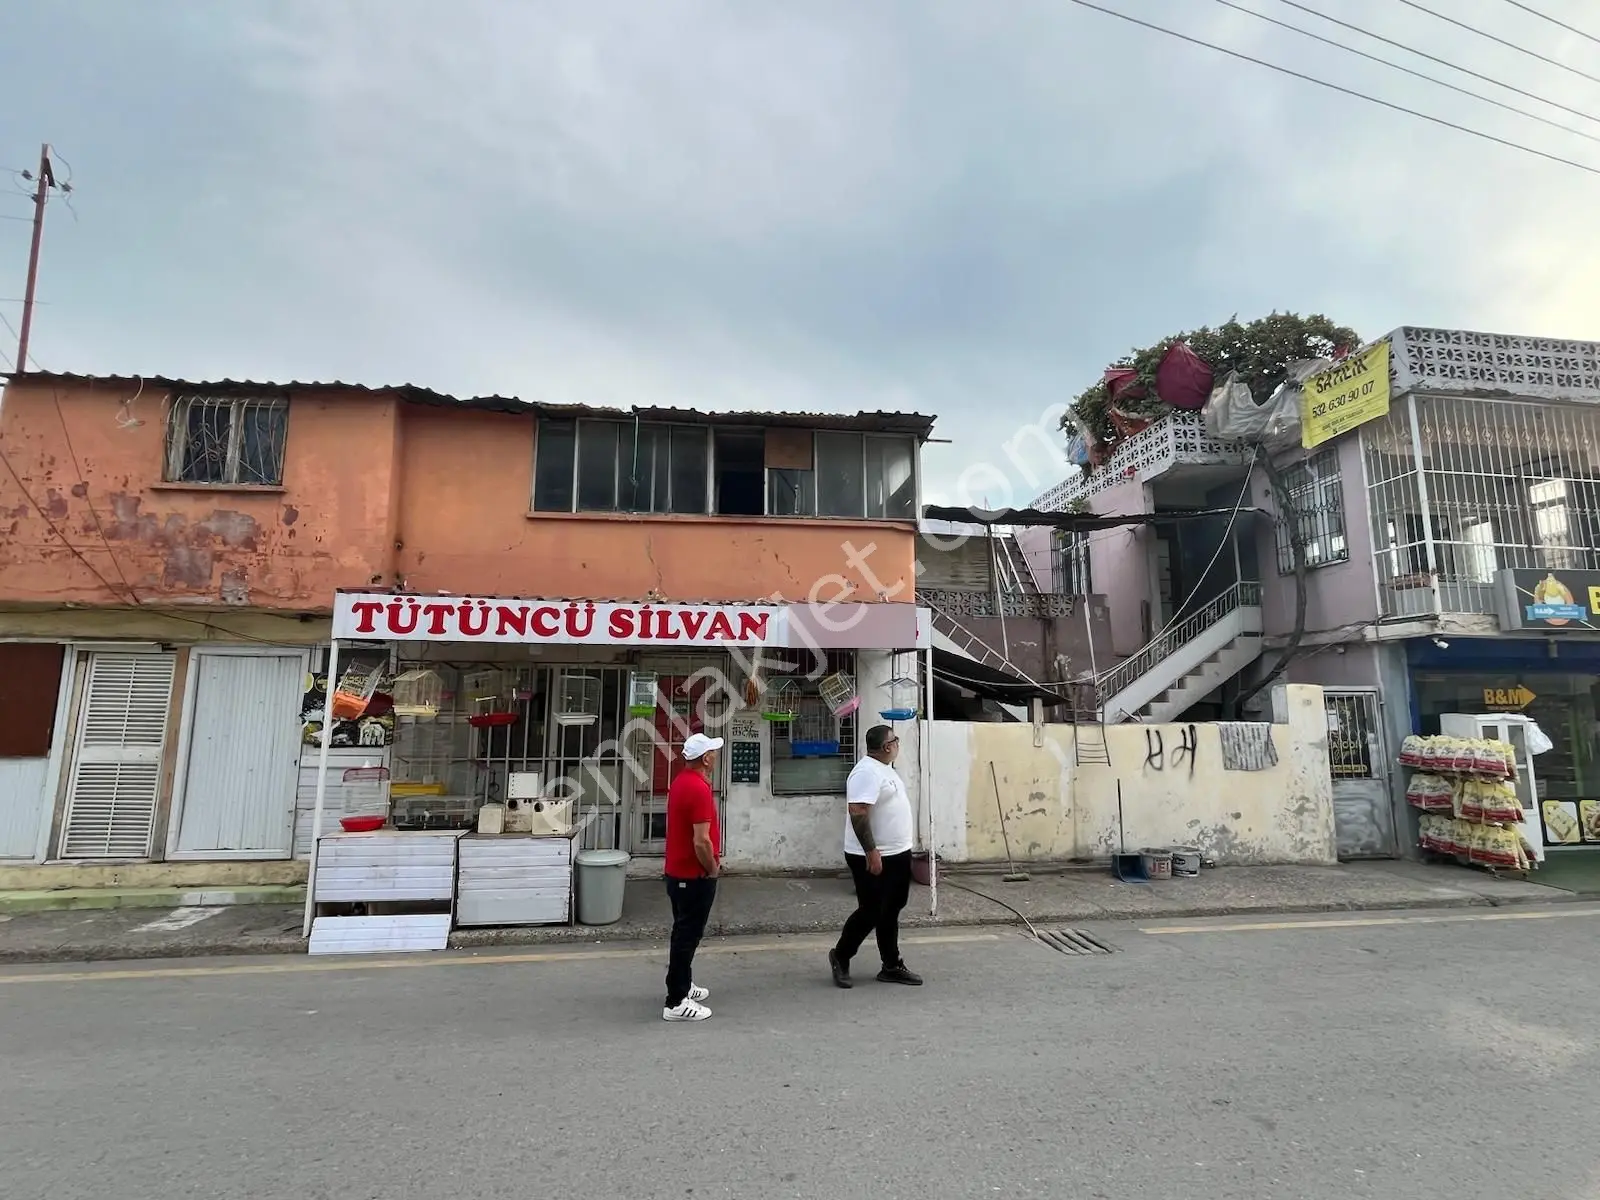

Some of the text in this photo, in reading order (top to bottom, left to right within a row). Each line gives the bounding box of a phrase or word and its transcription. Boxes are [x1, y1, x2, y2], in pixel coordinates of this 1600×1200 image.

[1329, 394, 1346, 411] 630
[1348, 388, 1360, 402] 90
[1361, 381, 1375, 395] 07
[352, 597, 770, 641] TÜTÜNCÜ SİLVAN
[1483, 688, 1524, 705] B&M
